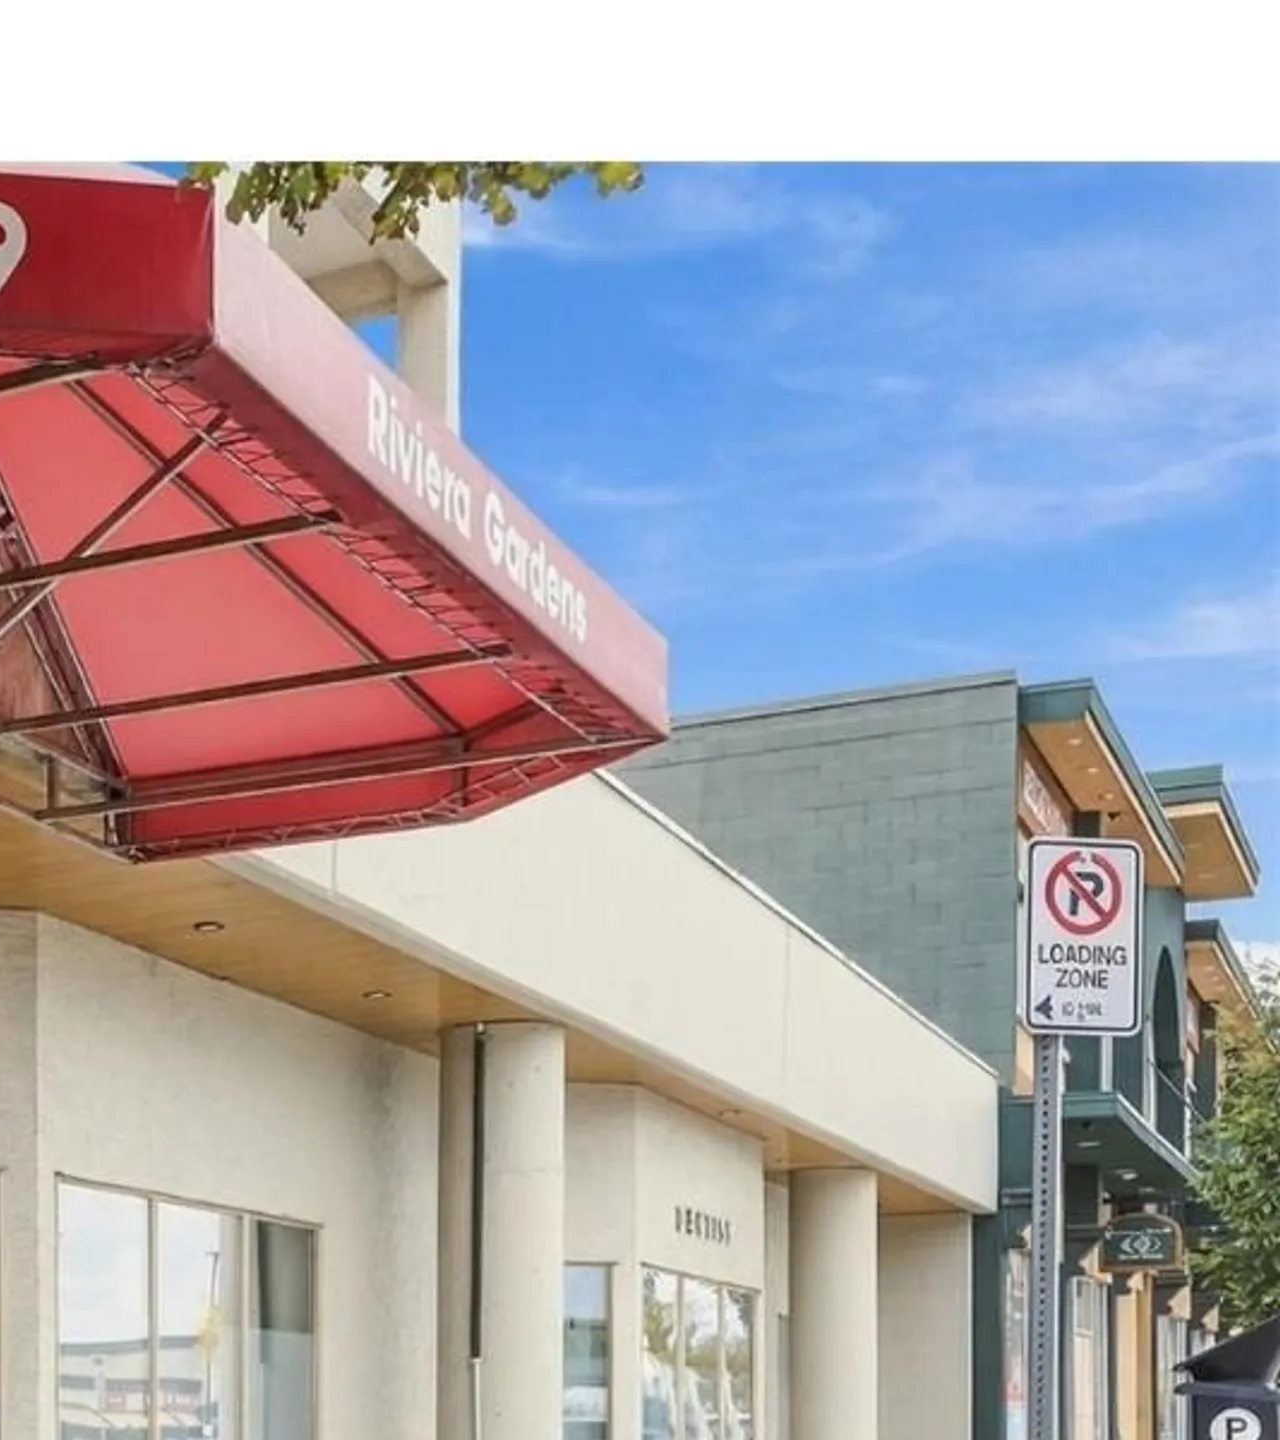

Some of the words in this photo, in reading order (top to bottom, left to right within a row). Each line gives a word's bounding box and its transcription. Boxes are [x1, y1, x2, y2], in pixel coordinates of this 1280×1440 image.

[368, 374, 472, 539] Riviera
[484, 490, 588, 644] Gardens
[1038, 943, 1128, 966] LOADING
[1055, 967, 1109, 990] ZONE
[1226, 1417, 1248, 1440] P
